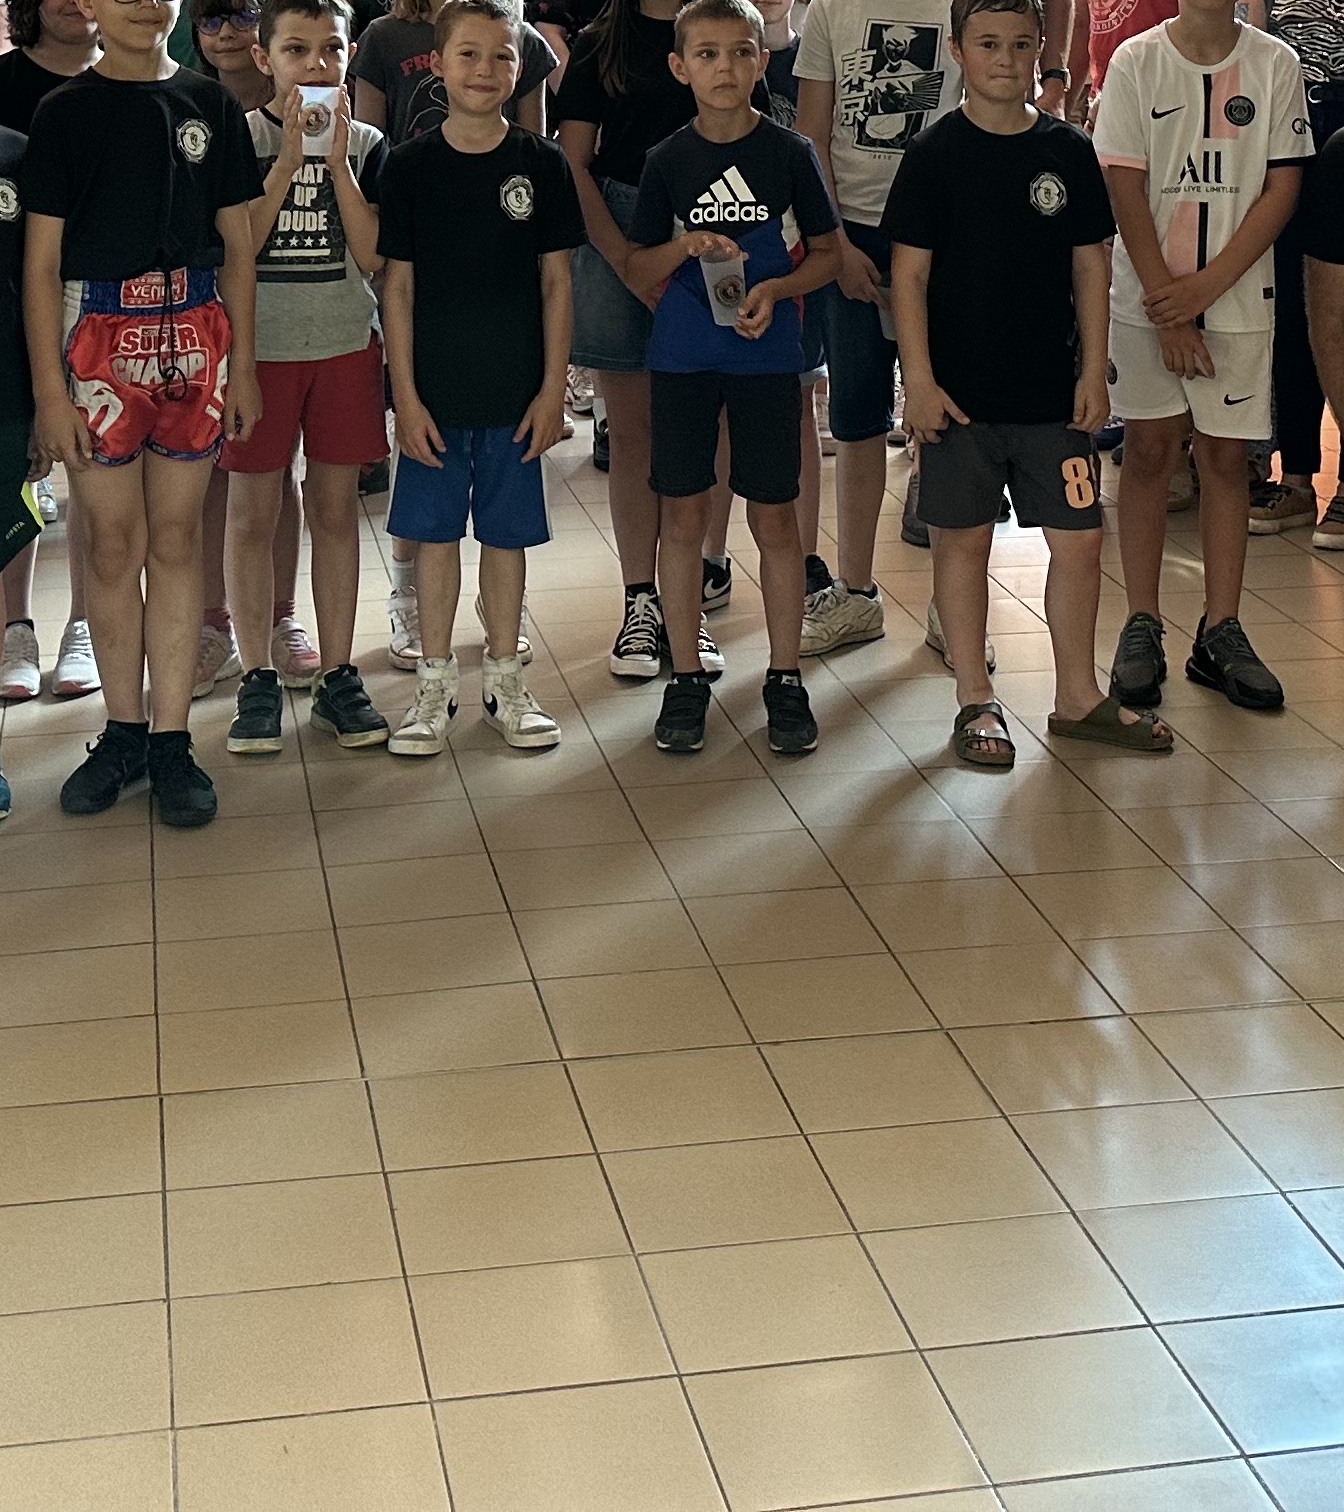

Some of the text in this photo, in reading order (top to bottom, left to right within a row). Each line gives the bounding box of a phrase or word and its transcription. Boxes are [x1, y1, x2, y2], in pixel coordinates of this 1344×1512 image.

[839, 49, 877, 127] 東京
[293, 184, 318, 207] UP
[278, 210, 327, 232] DUDE
[689, 201, 769, 225] adidas
